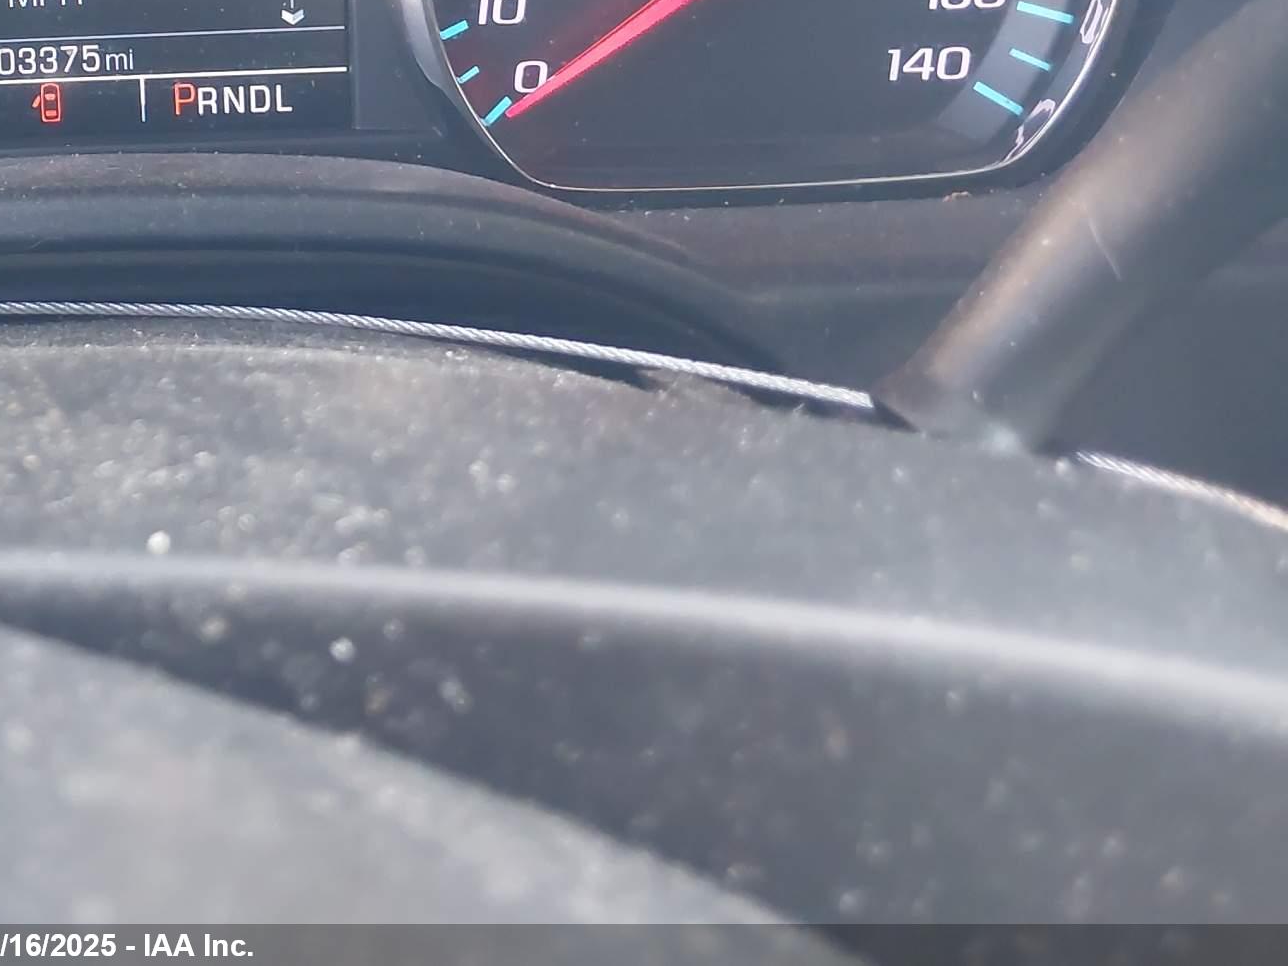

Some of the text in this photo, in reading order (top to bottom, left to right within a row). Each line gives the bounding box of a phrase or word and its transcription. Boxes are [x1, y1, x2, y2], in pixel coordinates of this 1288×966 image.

[515, 61, 549, 94] 0
[888, 47, 971, 80] 140
[175, 83, 292, 115] PRNDL
